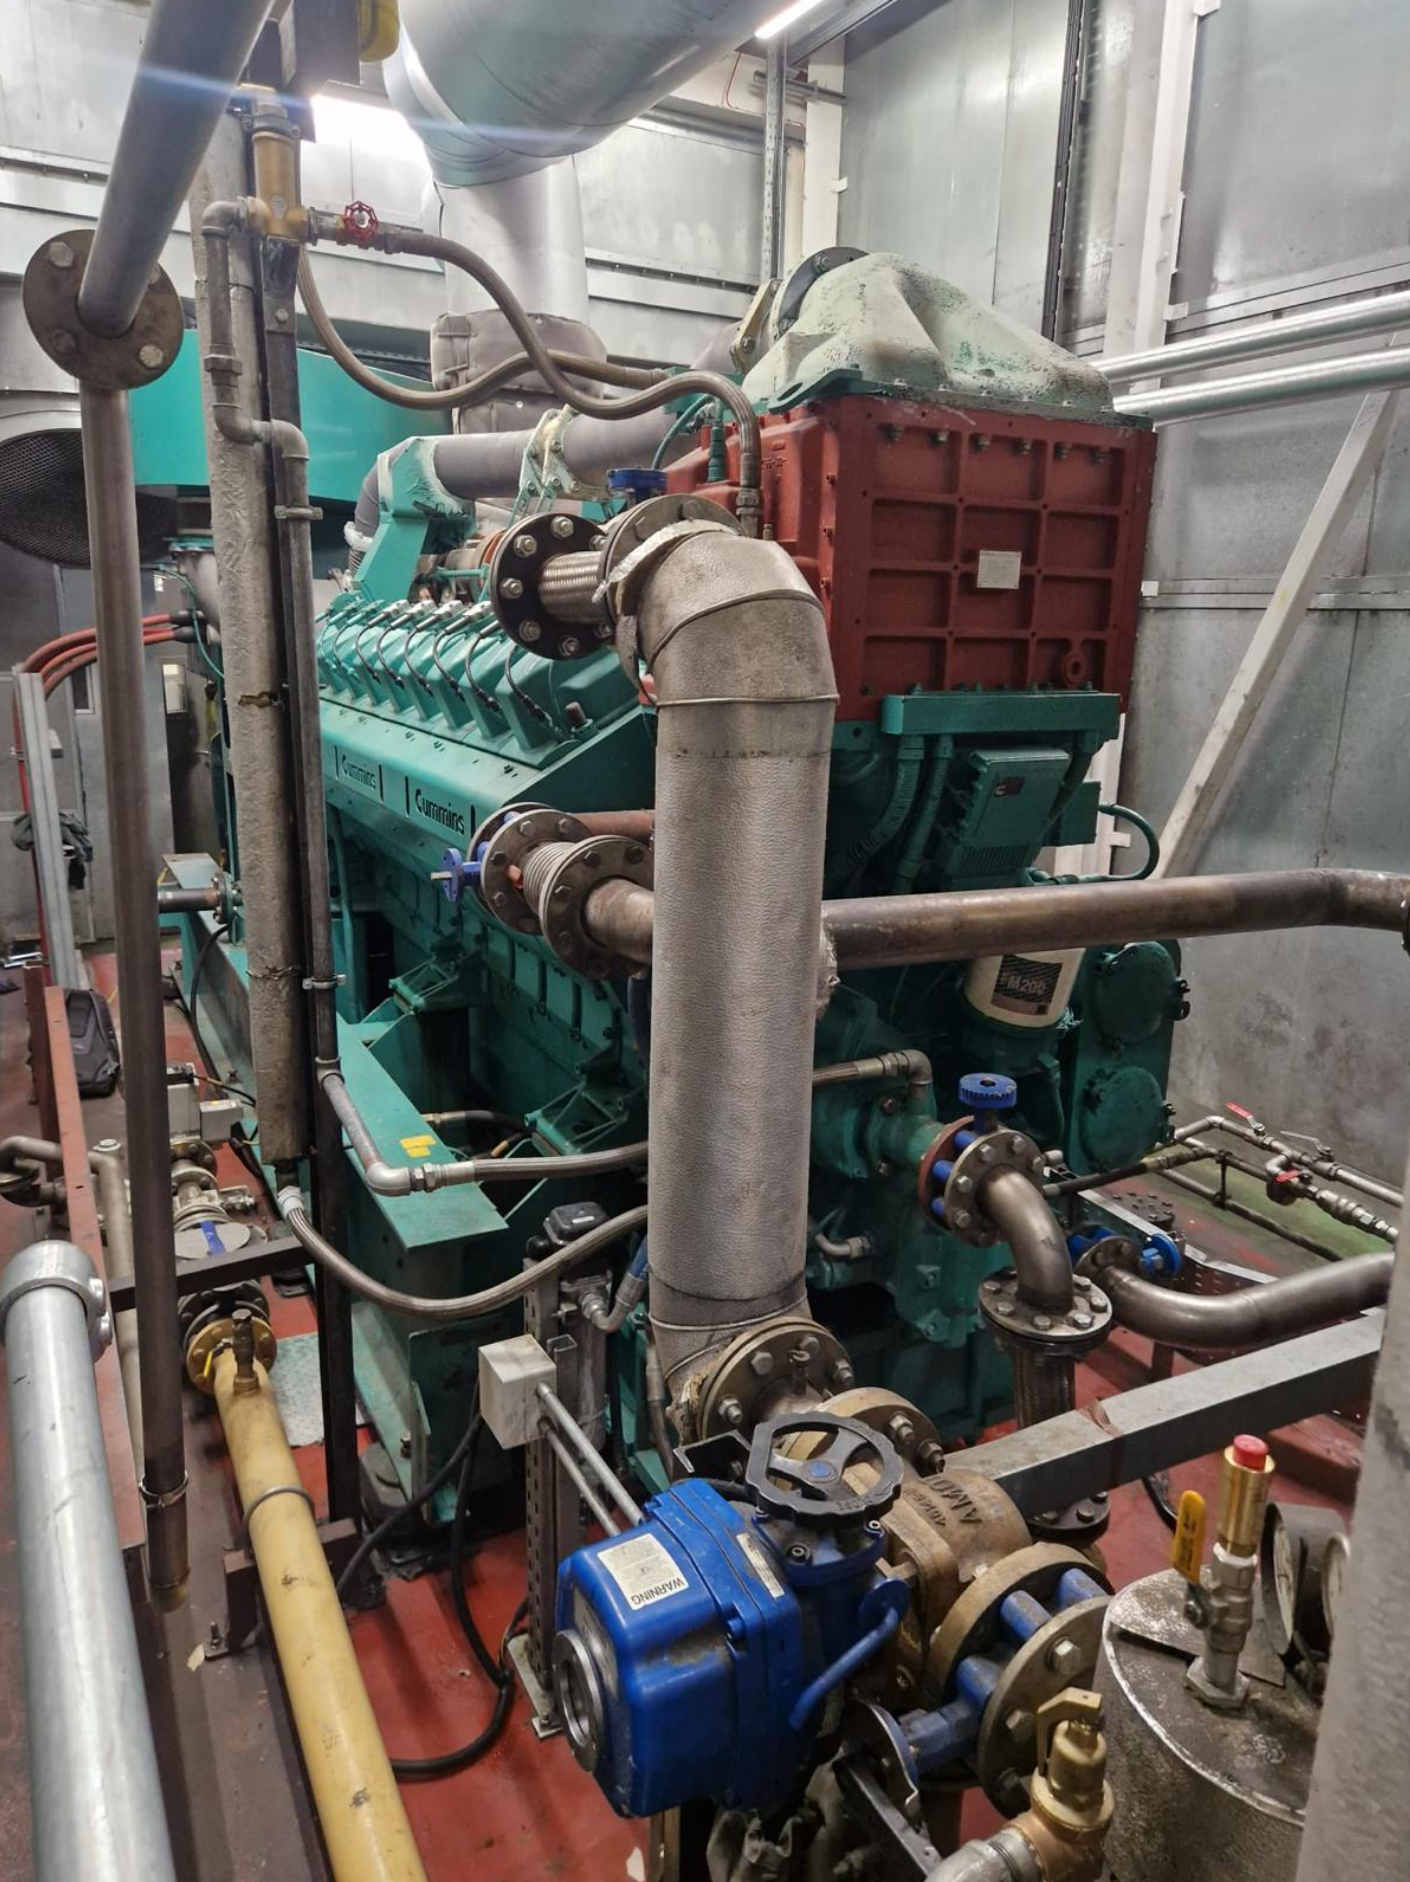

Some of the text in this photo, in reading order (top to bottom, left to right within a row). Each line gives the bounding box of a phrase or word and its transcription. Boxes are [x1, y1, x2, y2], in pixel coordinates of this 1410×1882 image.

[341, 754, 376, 790] Cummins
[415, 788, 465, 836] Cummins
[630, 1577, 685, 1605] WARNING
